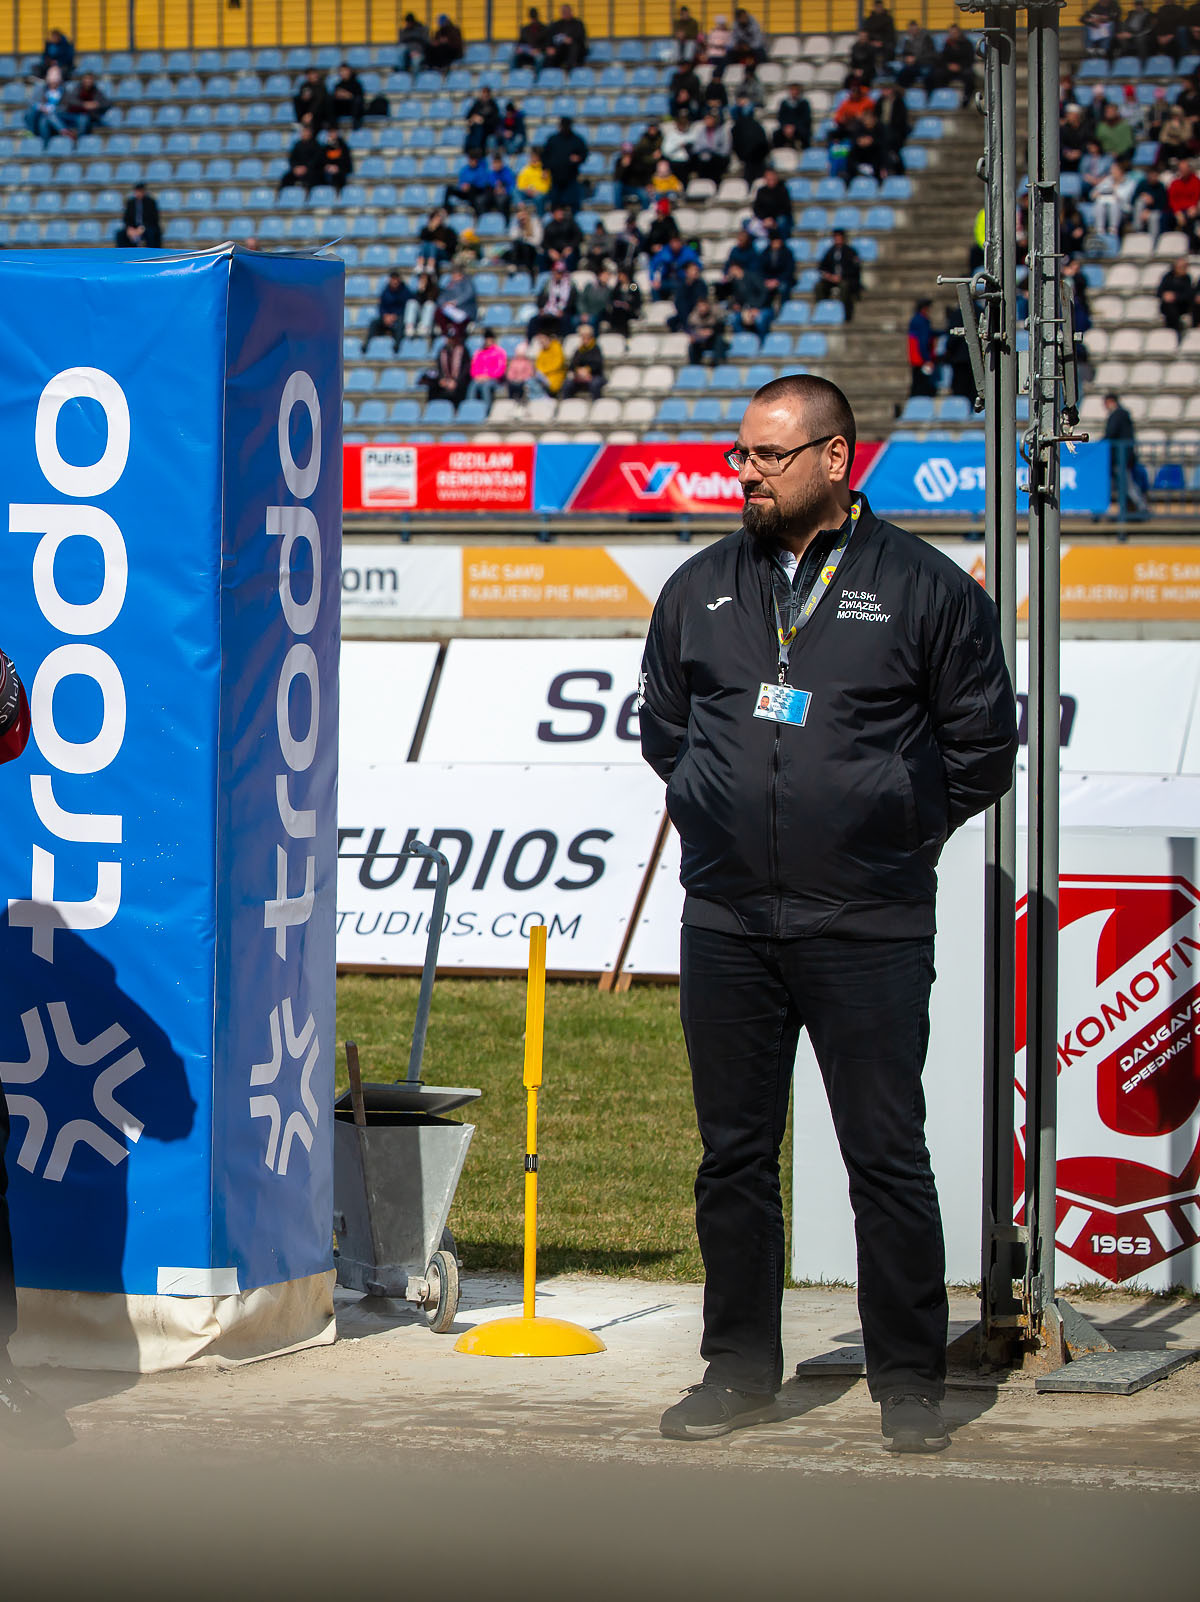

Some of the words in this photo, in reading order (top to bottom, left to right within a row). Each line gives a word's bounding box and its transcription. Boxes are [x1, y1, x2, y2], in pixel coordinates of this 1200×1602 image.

[836, 610, 892, 623] MOTOROWY
[838, 600, 882, 612] ZWIĄZEK
[841, 589, 876, 602] POLSKI
[8, 366, 130, 963] trodo
[264, 370, 321, 961] trodo
[1119, 998, 1200, 1073] DAUGAV
[1121, 1032, 1192, 1095] SPEEDWAY
[1090, 1234, 1152, 1256] 1963
